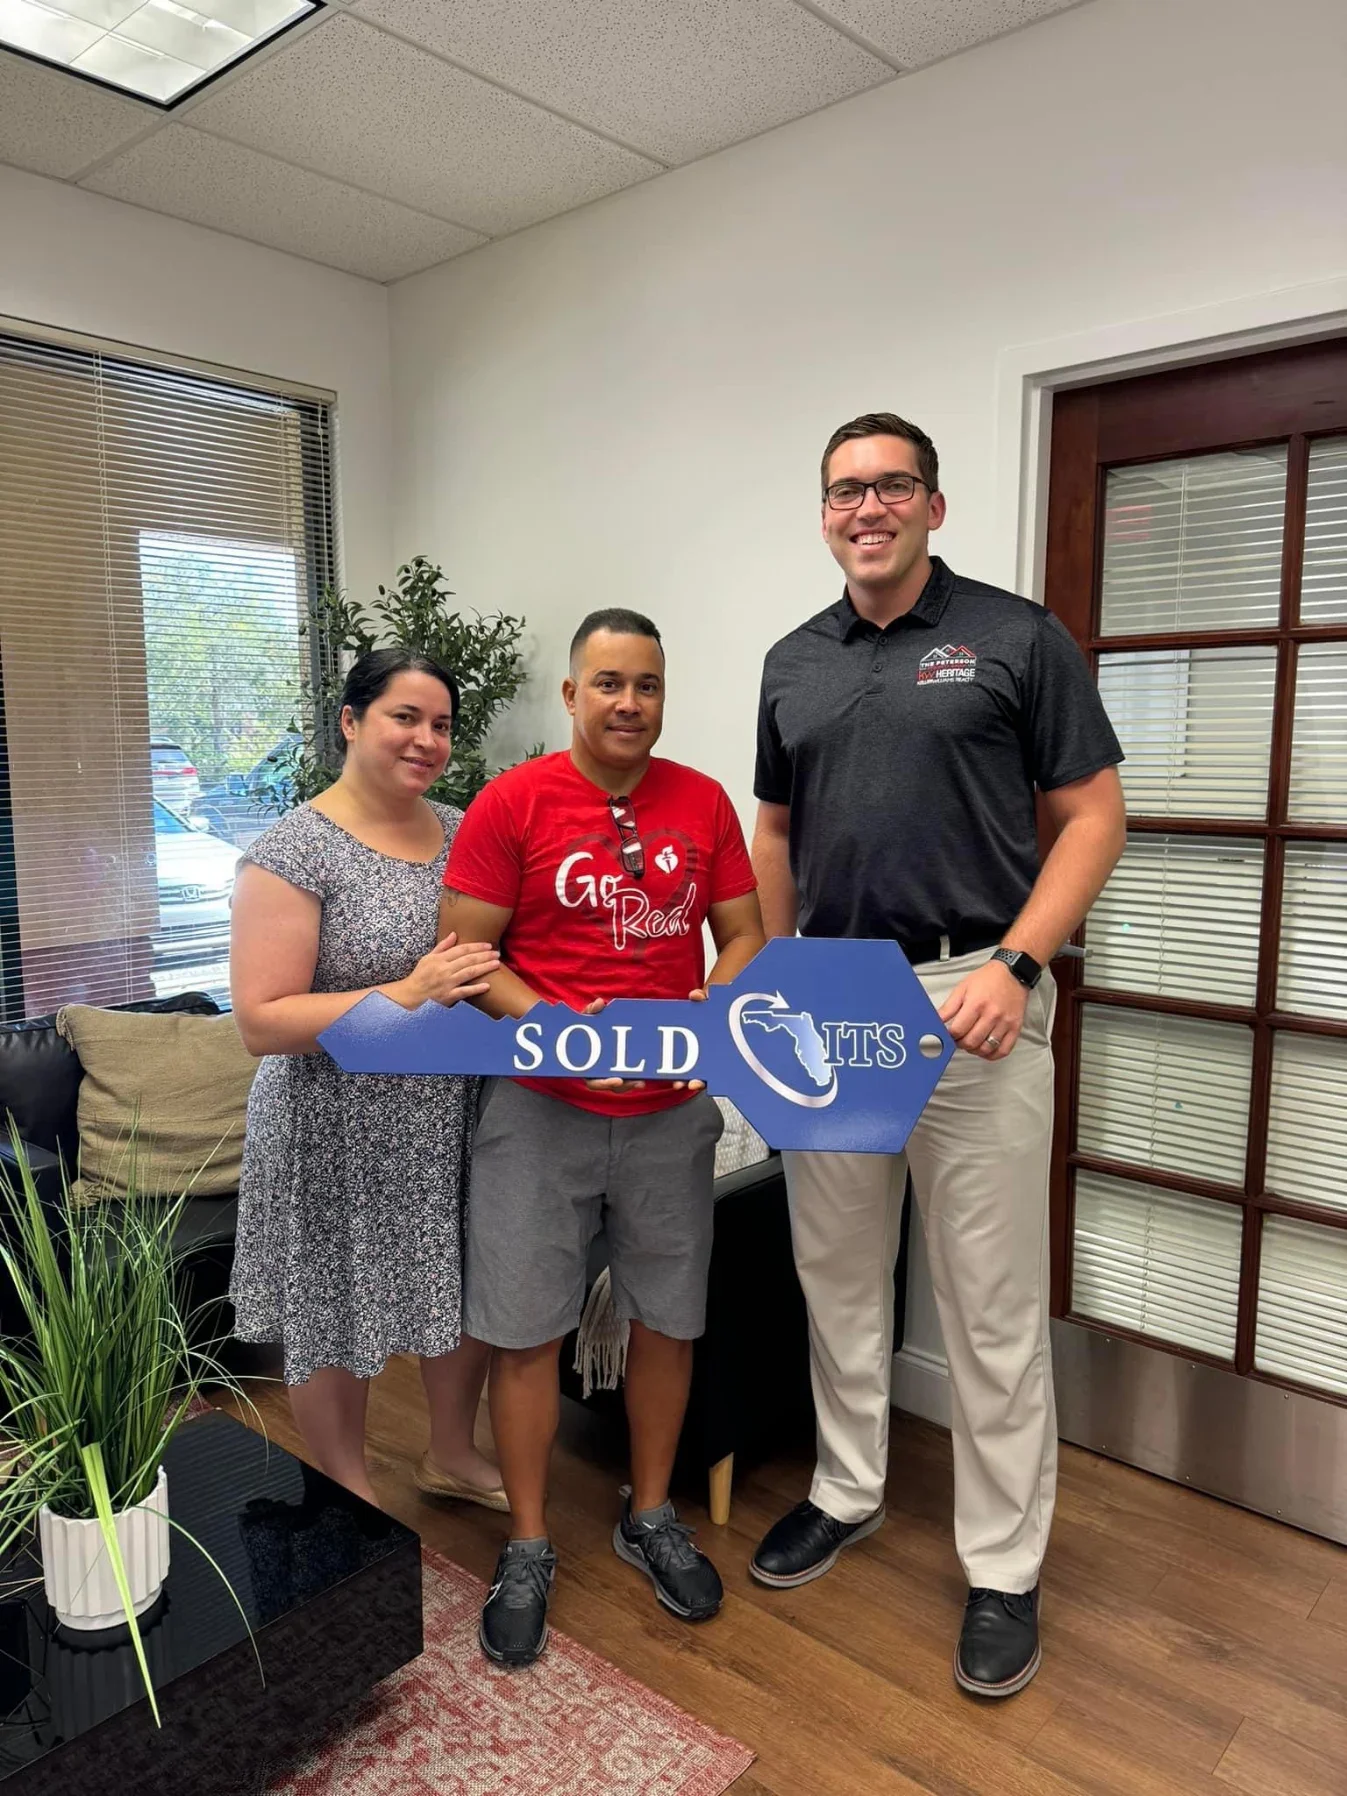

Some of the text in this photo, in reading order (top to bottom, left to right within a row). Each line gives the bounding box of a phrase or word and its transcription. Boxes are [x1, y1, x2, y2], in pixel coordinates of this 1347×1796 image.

[935, 668, 976, 678] HERITAGE
[555, 851, 624, 908] Go
[603, 883, 696, 951] Red
[513, 1022, 700, 1075] SOLD
[823, 1023, 906, 1068] ITS
